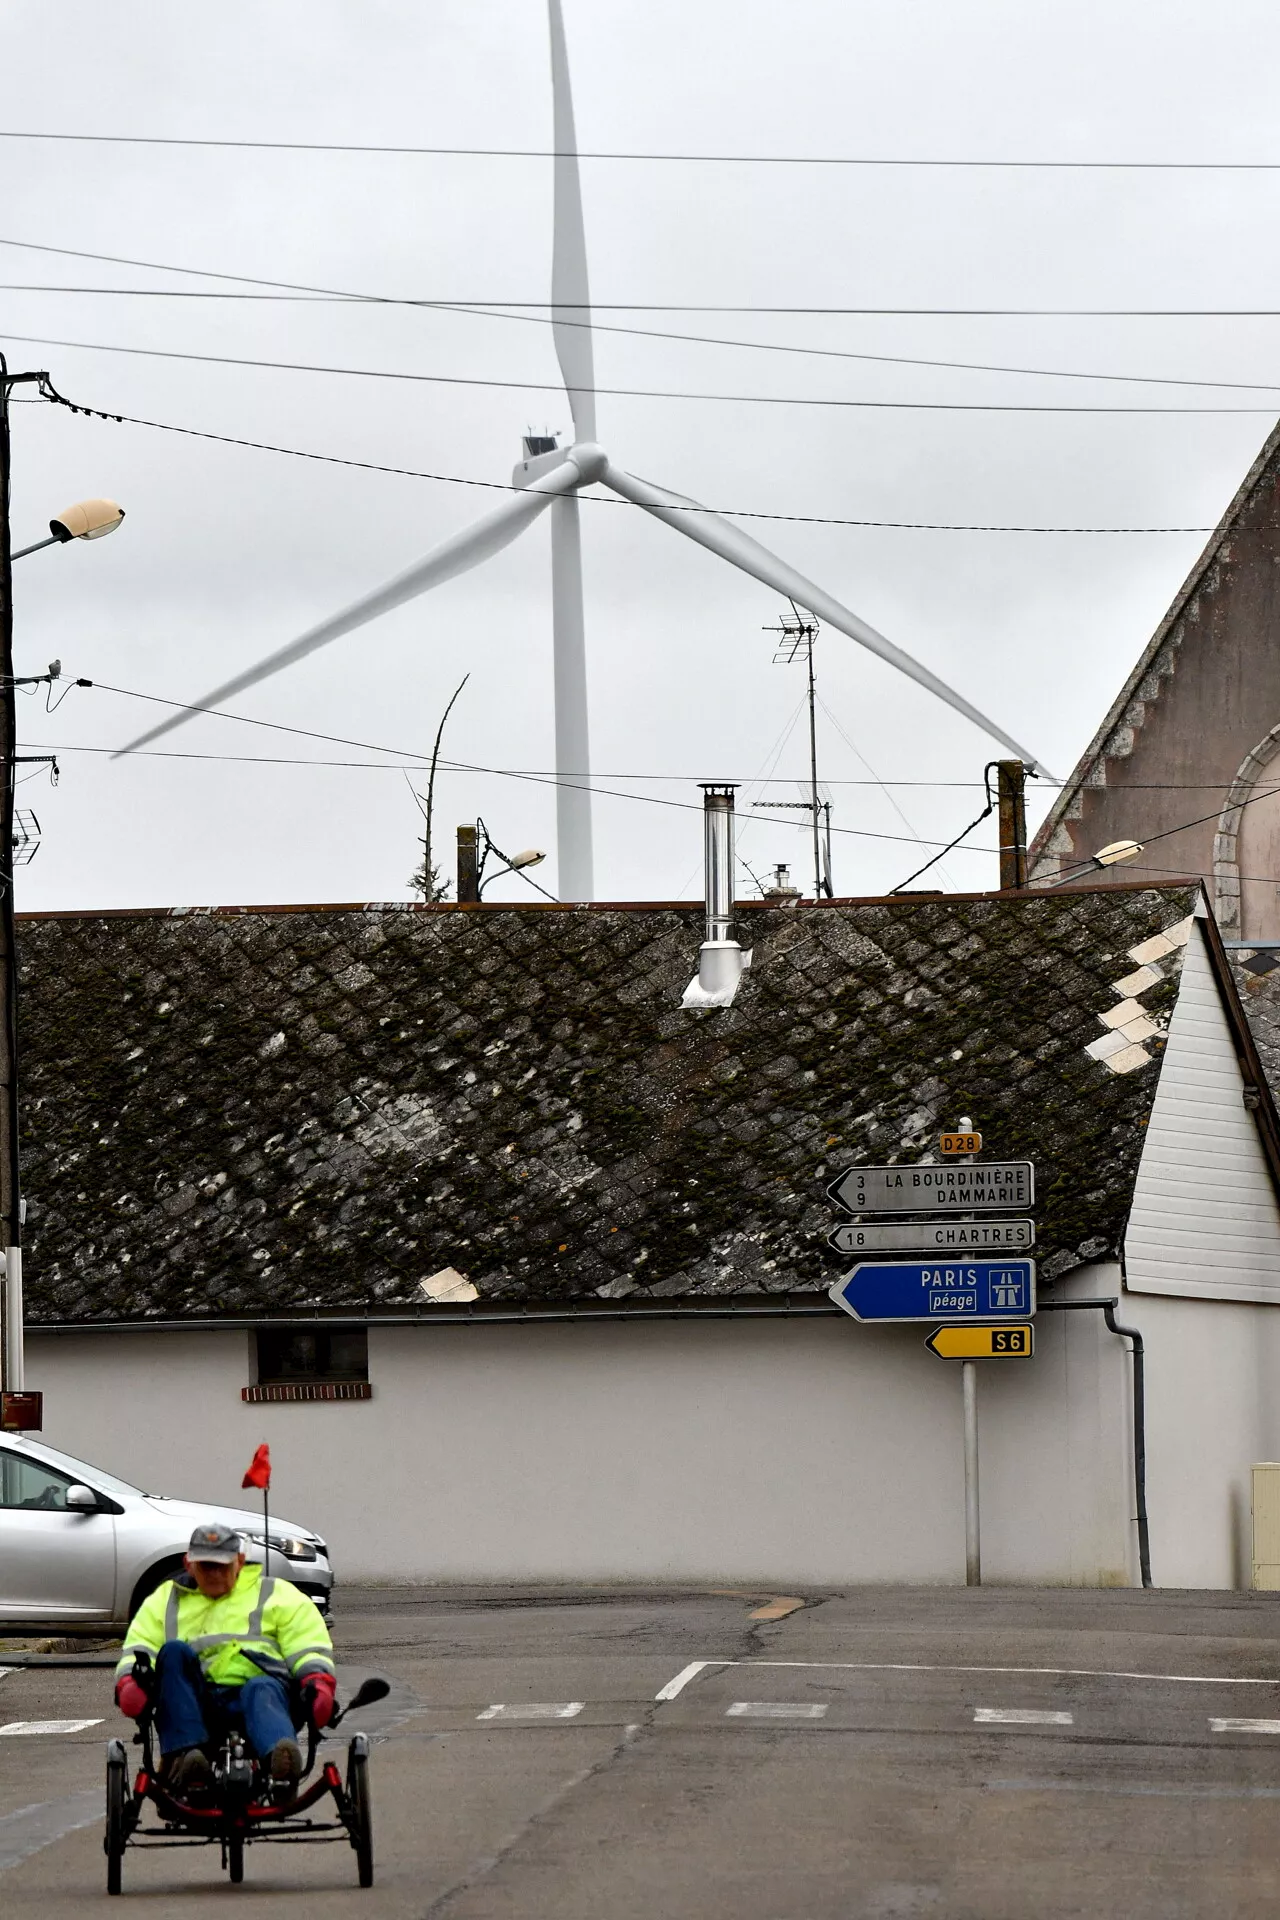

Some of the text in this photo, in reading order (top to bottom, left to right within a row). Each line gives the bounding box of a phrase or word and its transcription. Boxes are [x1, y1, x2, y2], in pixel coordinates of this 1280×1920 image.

[857, 1169, 1025, 1188] 3 LA BOURDINIÈRE
[857, 1188, 1025, 1205] 9 DAMMARIE
[847, 1228, 1025, 1245] 18 CHARTRES
[922, 1270, 977, 1286] PARIS
[934, 1293, 973, 1310] péage
